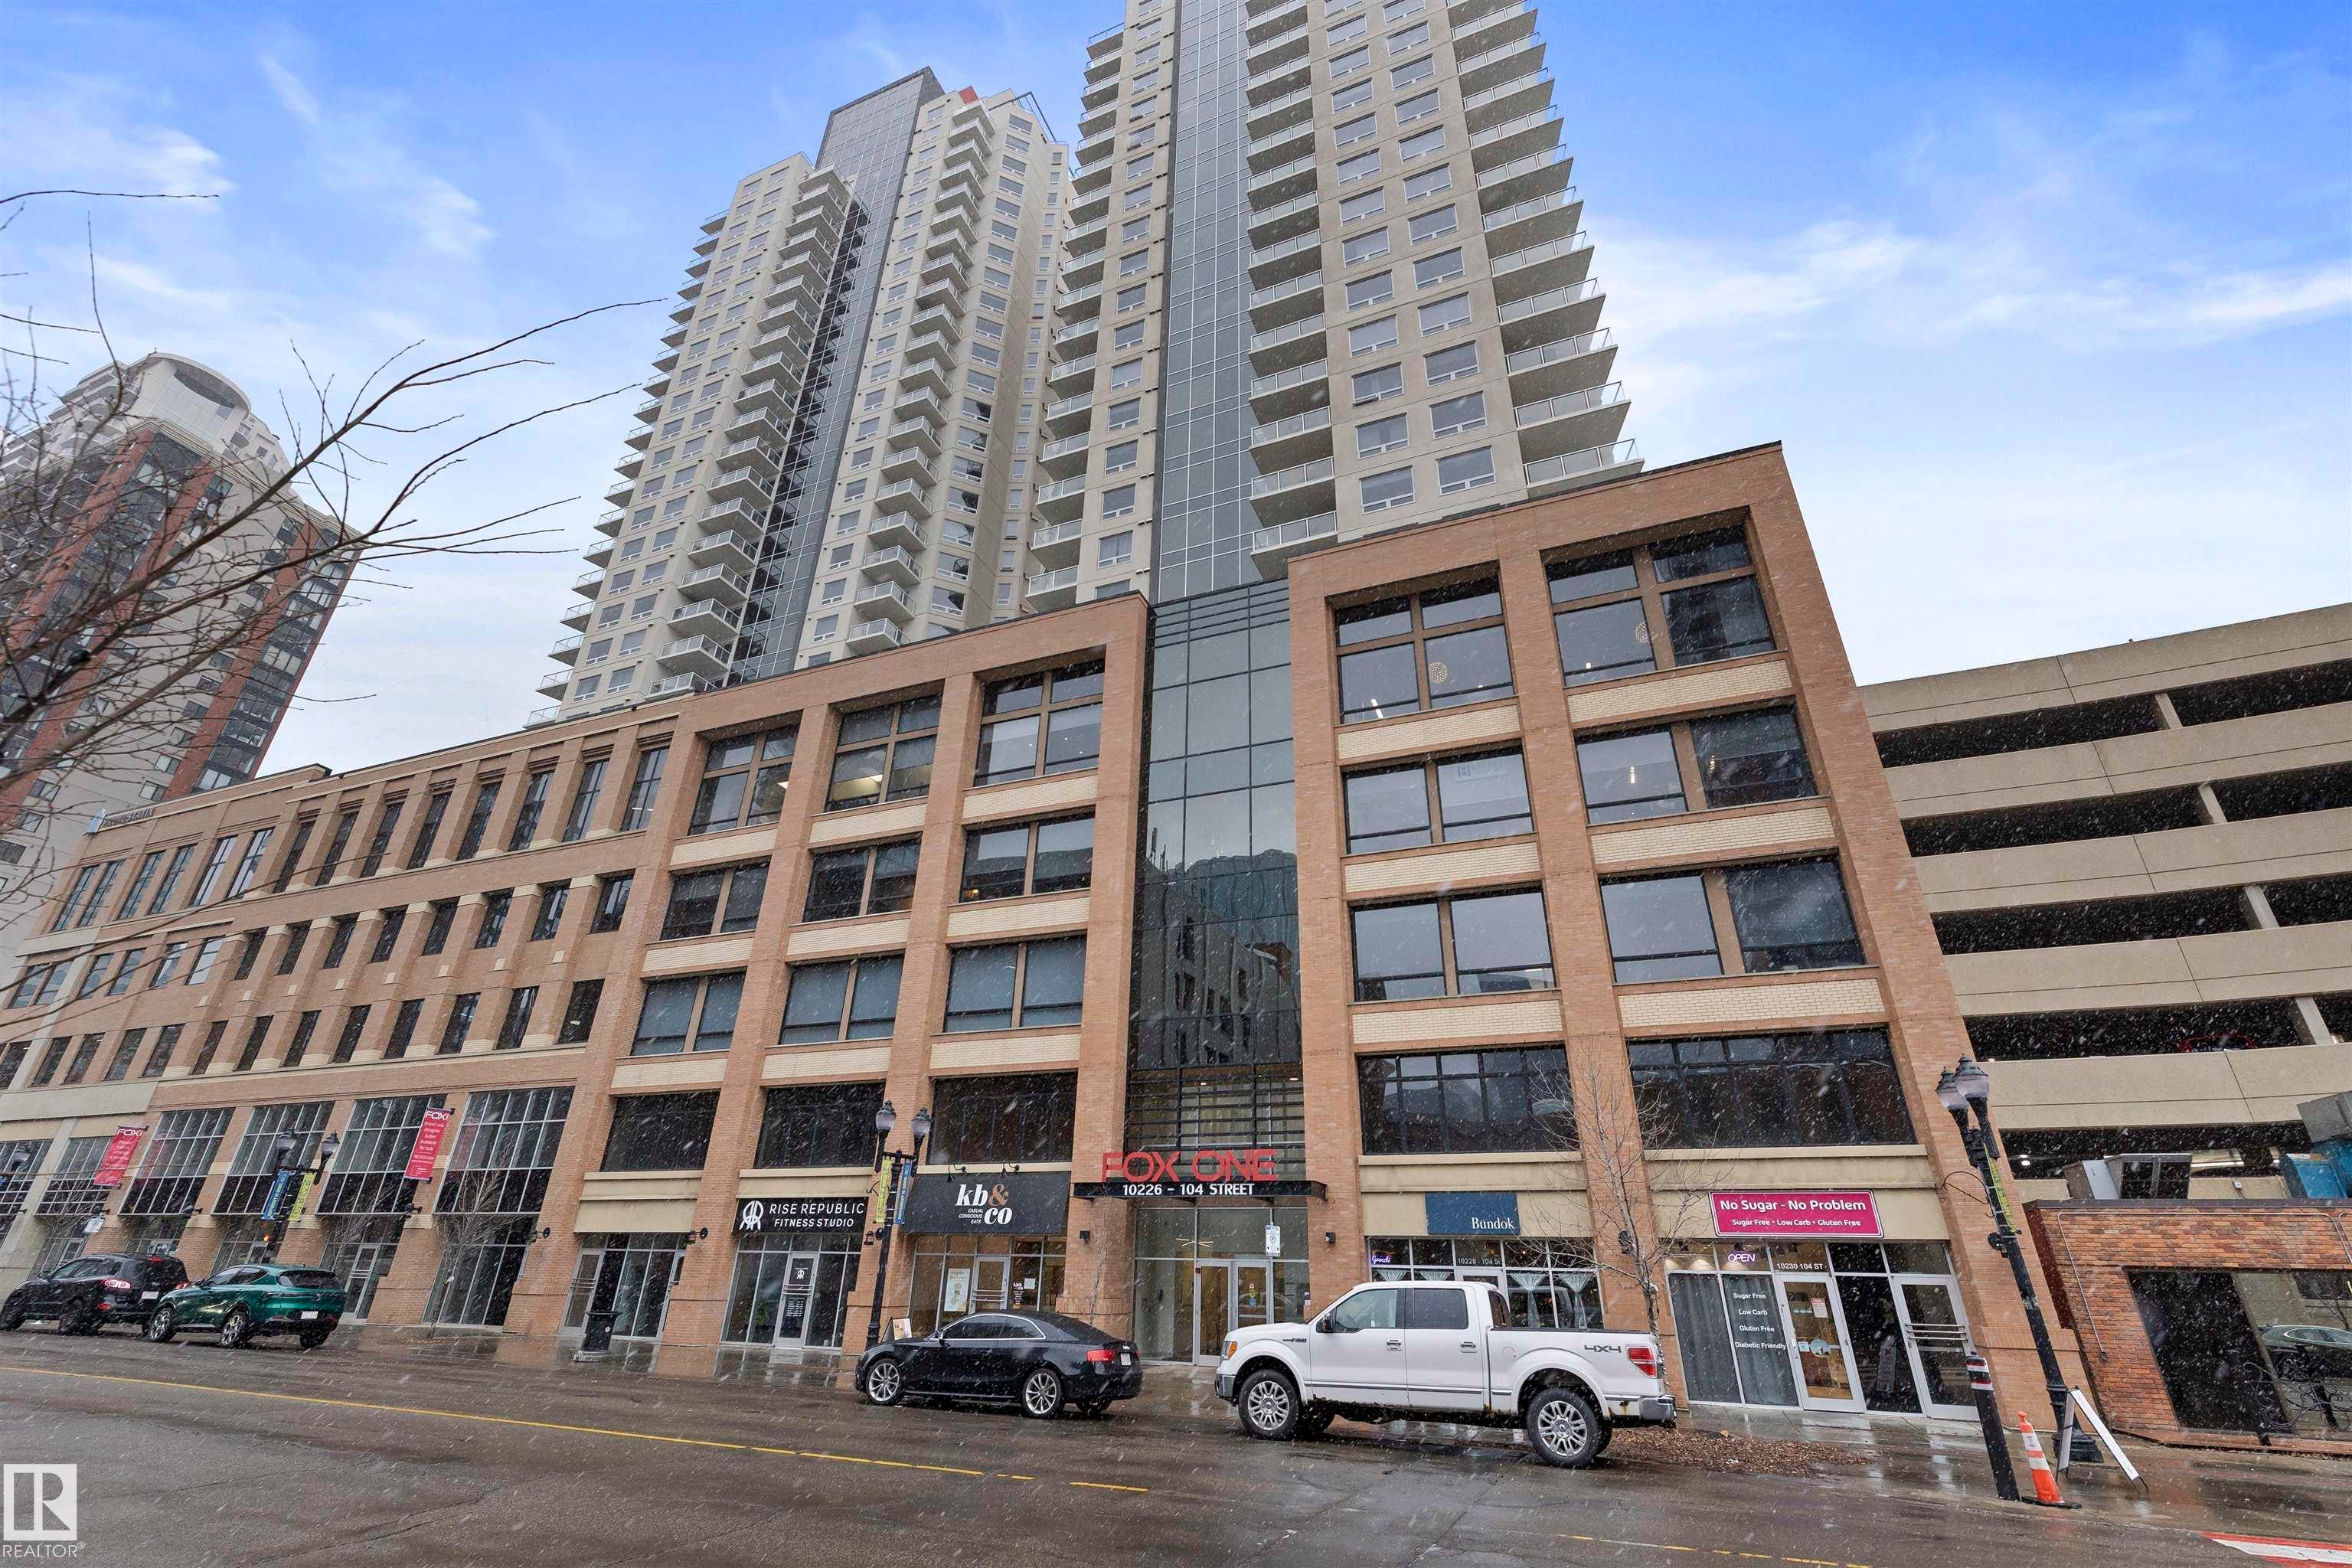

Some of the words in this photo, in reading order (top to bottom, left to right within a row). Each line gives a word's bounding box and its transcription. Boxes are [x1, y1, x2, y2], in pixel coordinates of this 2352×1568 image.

[425, 1111, 446, 1121] FOX
[116, 1129, 141, 1137] FOX
[1102, 1151, 1181, 1183] FOX
[1191, 1148, 1278, 1182] ONE
[955, 1184, 1009, 1207] kb&
[1122, 1184, 1162, 1196] 10226
[1180, 1184, 1204, 1196] 104
[1209, 1183, 1255, 1195] STREET
[769, 1204, 797, 1214] RISE
[800, 1203, 865, 1214] REPUBLIC
[1720, 1200, 1739, 1210] No
[1741, 1200, 1778, 1213] Sugar
[1788, 1200, 1807, 1210] No
[1810, 1200, 1867, 1210] Problem
[774, 1218, 815, 1227] FITNESS
[816, 1218, 854, 1227] STUDIO
[1471, 1217, 1515, 1230] Bündok
[1727, 1253, 1756, 1263] OPEN
